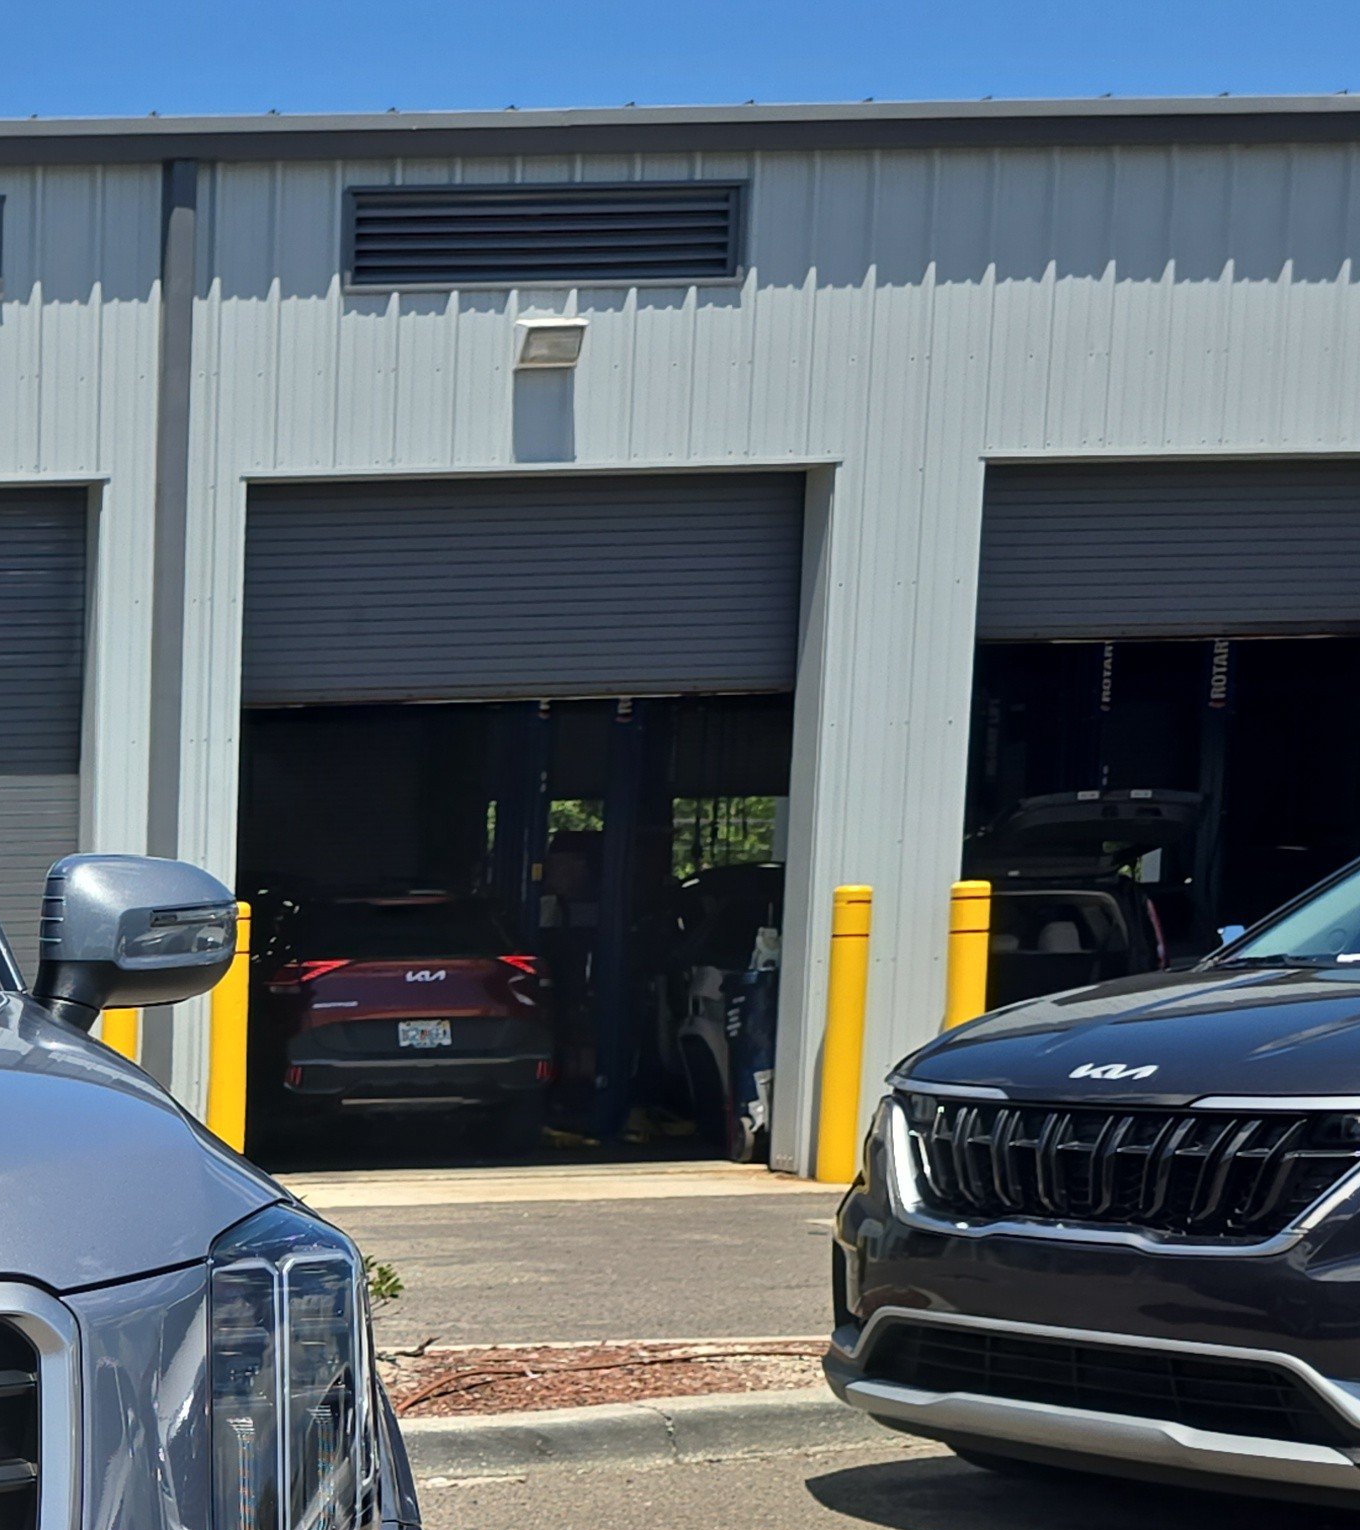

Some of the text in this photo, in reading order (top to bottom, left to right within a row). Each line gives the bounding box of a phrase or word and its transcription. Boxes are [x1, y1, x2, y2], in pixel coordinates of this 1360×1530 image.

[1100, 641, 1114, 703] ROTAR
[1209, 640, 1230, 700] ROTAR
[1068, 1062, 1159, 1080] KIA
